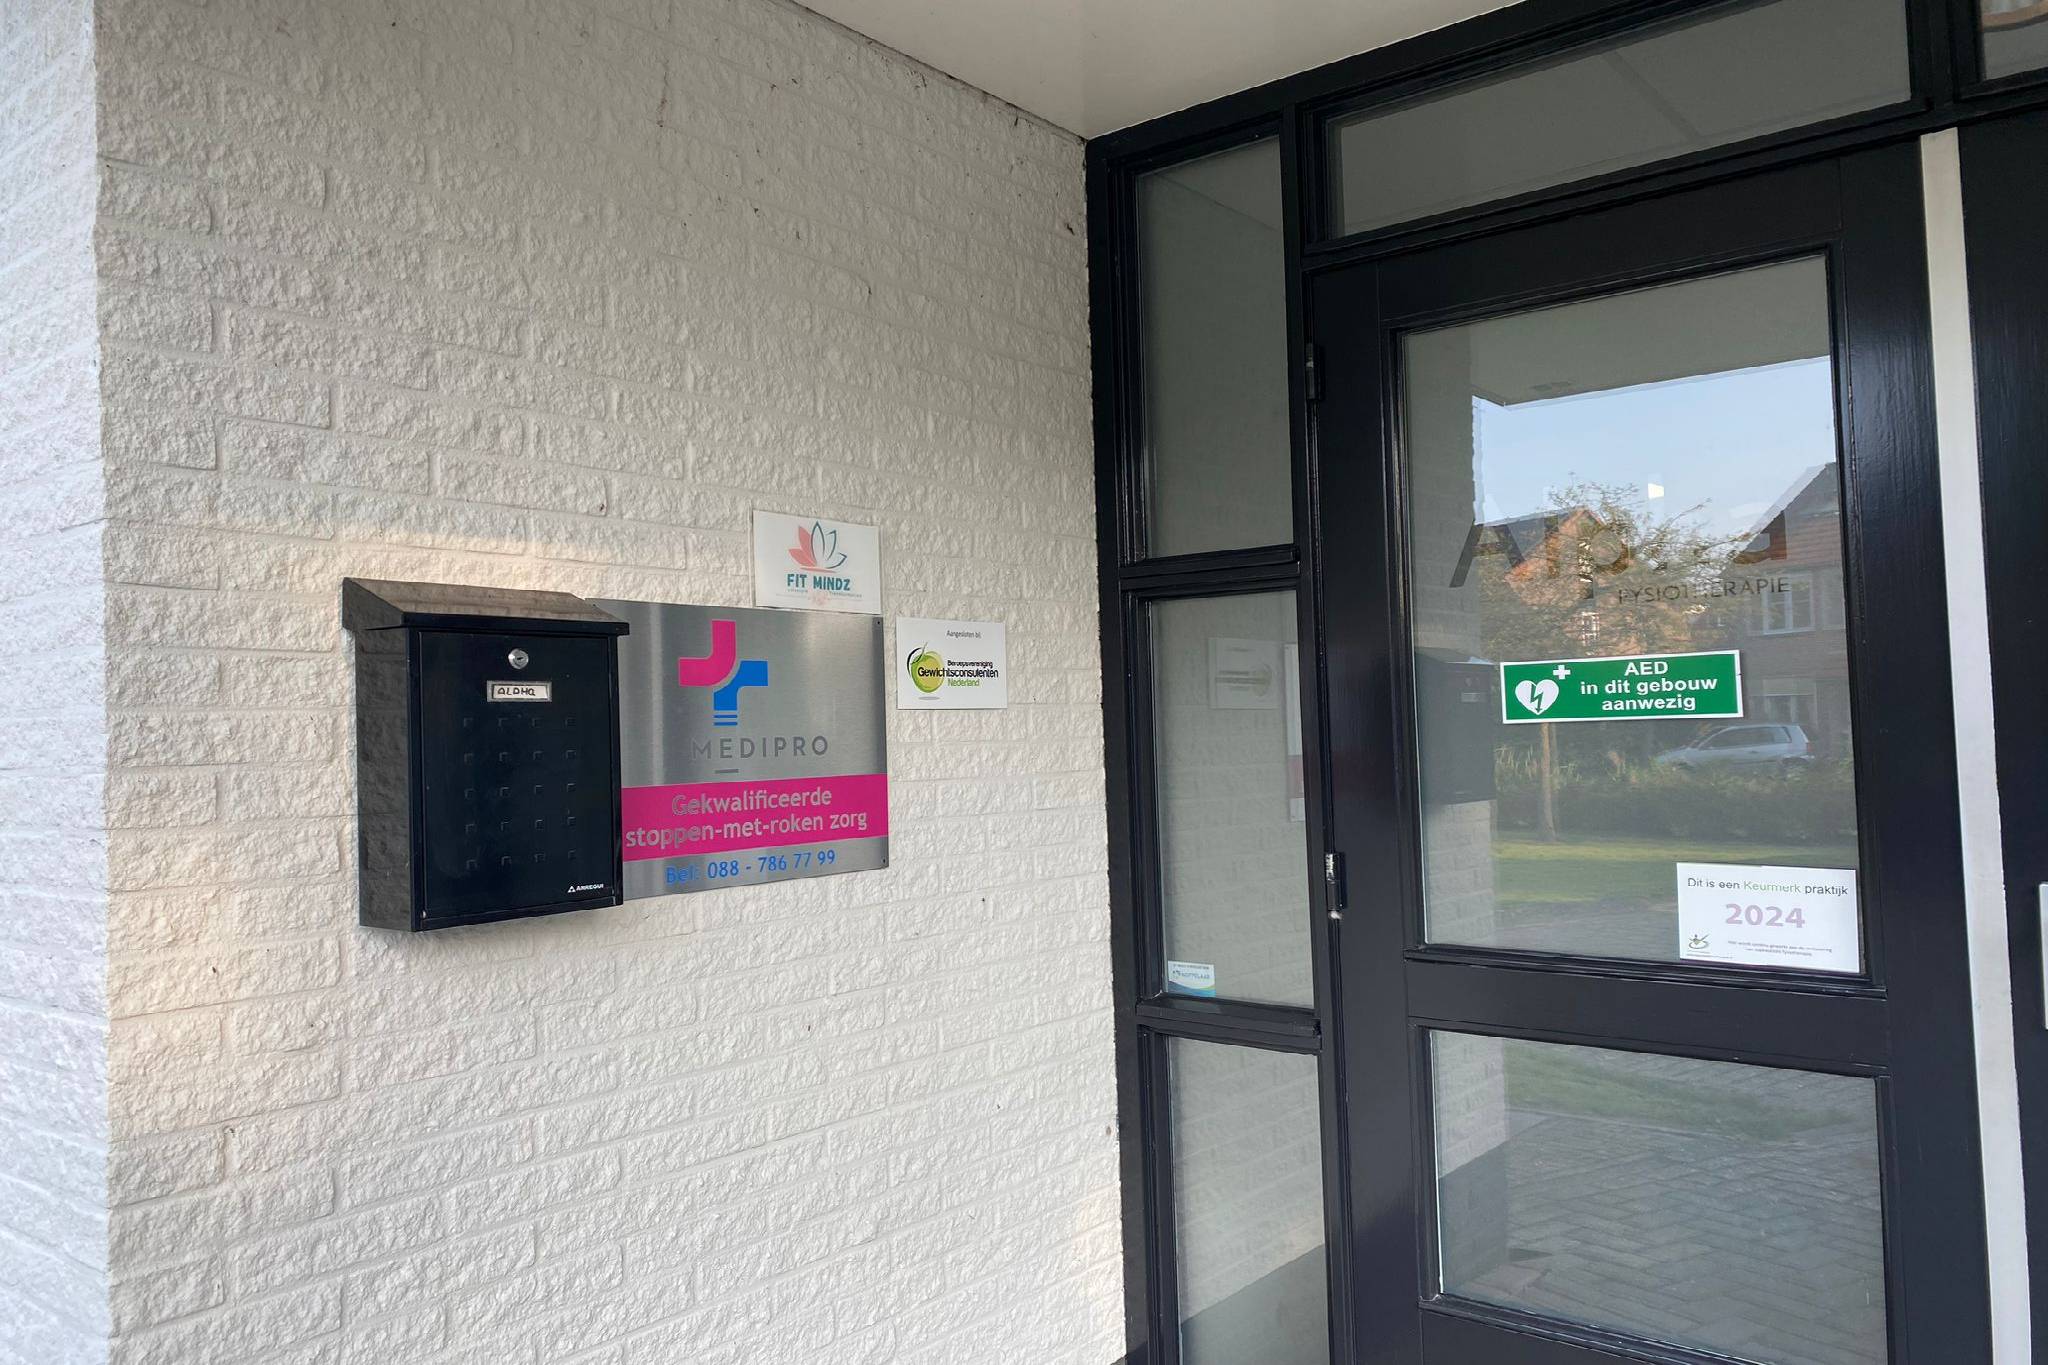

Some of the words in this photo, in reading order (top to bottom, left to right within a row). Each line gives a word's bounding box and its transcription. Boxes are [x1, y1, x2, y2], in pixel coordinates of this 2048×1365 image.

[787, 573, 808, 588] FIT
[813, 575, 851, 591] MINDZ
[917, 666, 999, 678] Gewichtsconsulenten
[1624, 661, 1669, 676] AED
[947, 678, 980, 687] Nederland
[1580, 681, 1598, 695] in
[1605, 678, 1631, 695] dit
[1636, 676, 1718, 696] gebouw
[1602, 694, 1696, 711] aanwezig
[691, 735, 829, 760] MEDIPRO
[672, 787, 832, 815] Gekwalificeerde
[626, 812, 824, 849] stoppen-met-roken
[830, 810, 867, 831] zorg
[707, 860, 739, 879] 088
[758, 855, 788, 873] 786
[793, 852, 812, 869] 77
[817, 849, 836, 865] 99
[1687, 877, 1703, 887] Dit
[1706, 879, 1715, 888] is
[1718, 881, 1741, 889] een
[1743, 880, 1802, 893] Keurmerk
[1804, 884, 1849, 897] praktijk
[1725, 903, 1806, 928] 2024
